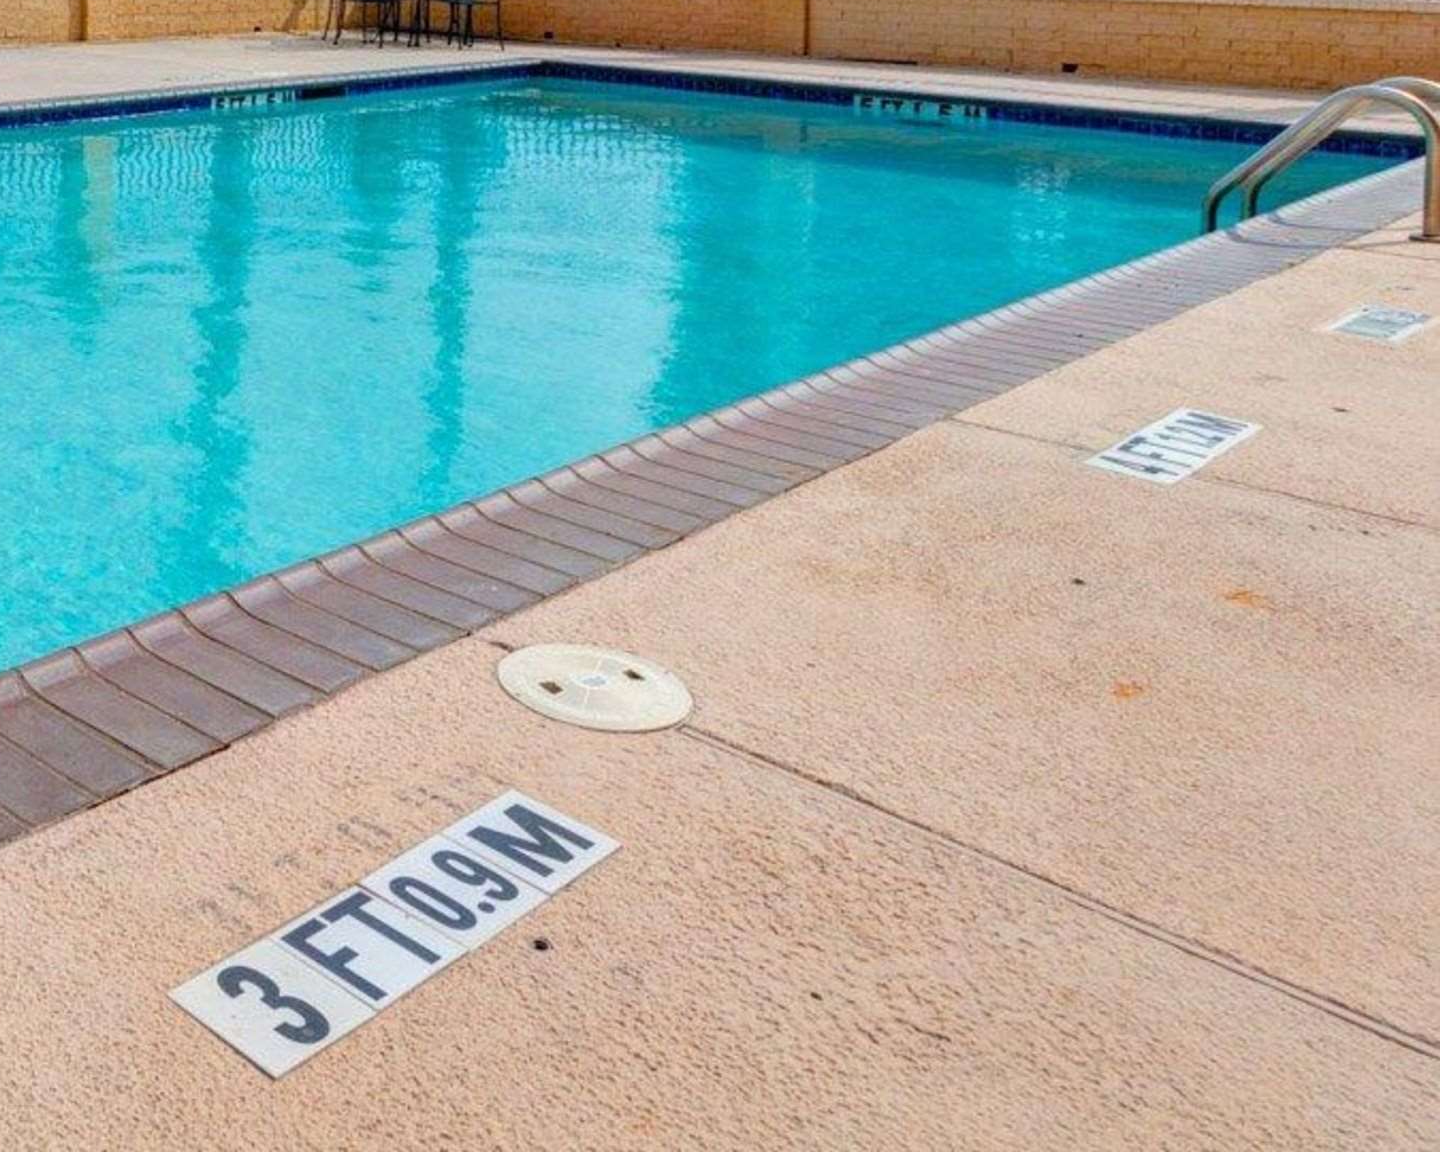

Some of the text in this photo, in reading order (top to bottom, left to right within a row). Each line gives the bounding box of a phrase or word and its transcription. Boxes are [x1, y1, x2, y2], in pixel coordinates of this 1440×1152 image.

[1176, 411, 1249, 436] M
[1100, 455, 1180, 477] 4
[1117, 436, 1208, 468] FT
[216, 803, 597, 1045] 3 FT 0.9 M
